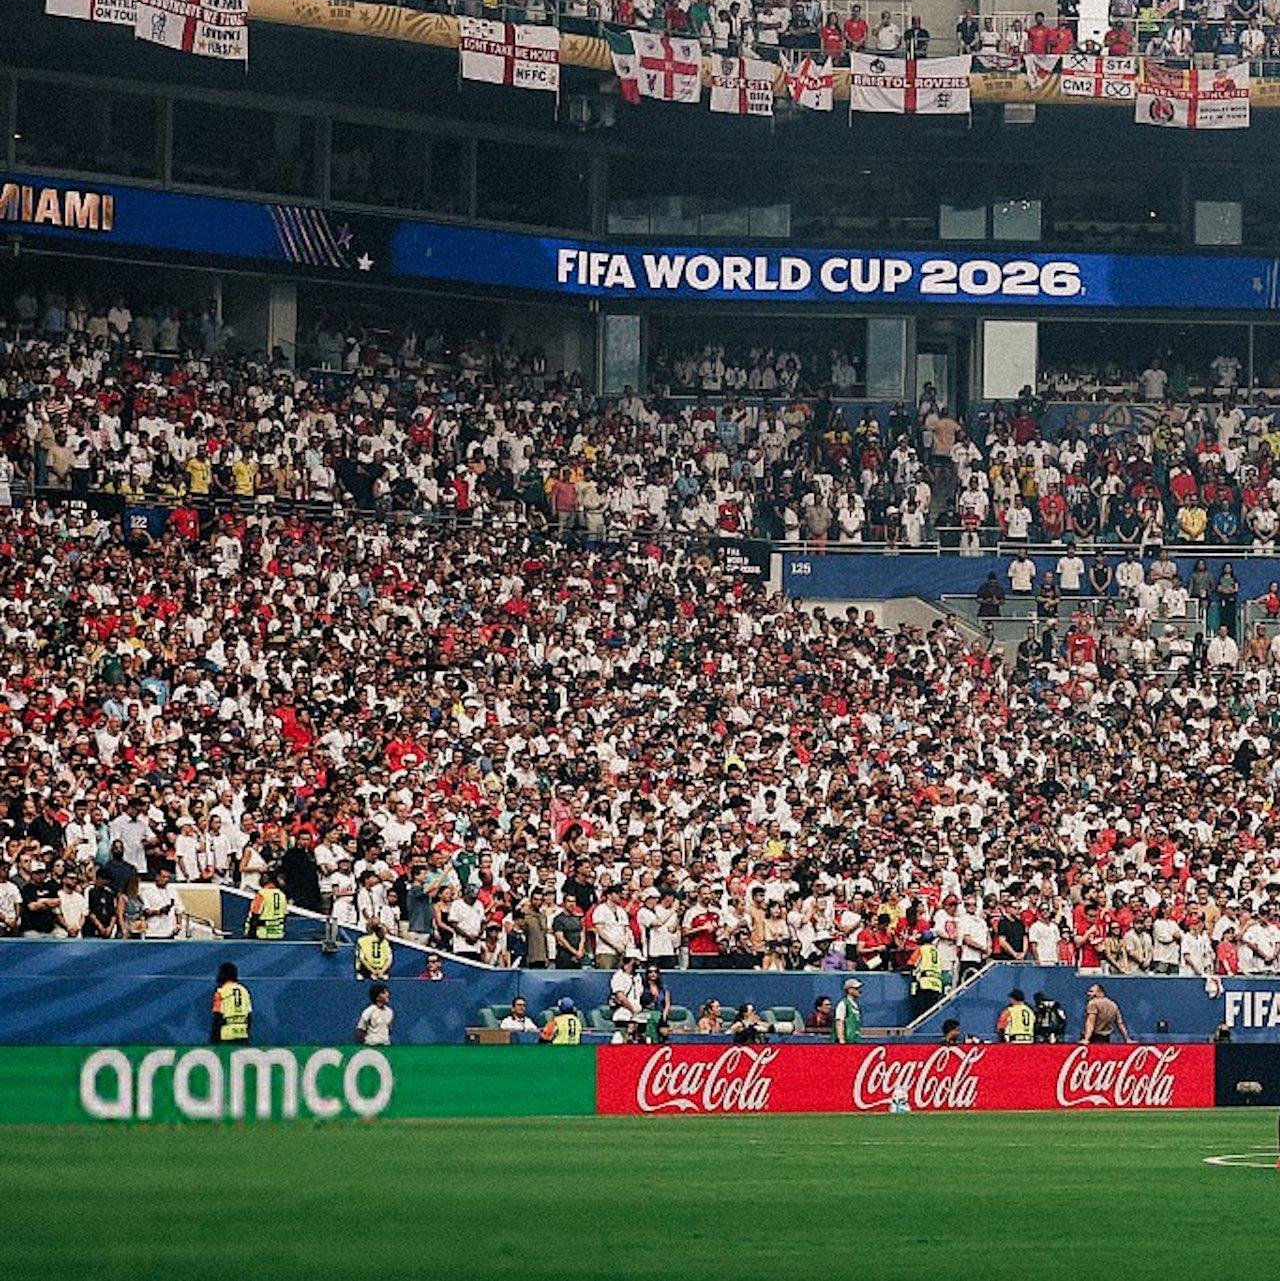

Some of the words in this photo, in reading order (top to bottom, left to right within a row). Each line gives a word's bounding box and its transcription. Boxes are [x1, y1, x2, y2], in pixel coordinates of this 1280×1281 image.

[853, 75, 911, 89] BRISTOL
[915, 77, 968, 89] ROVERS
[1062, 79, 1093, 92] CM2
[1106, 59, 1131, 70] ST4
[558, 248, 639, 289] FIFA
[642, 253, 812, 293] WORLD
[820, 258, 912, 294] CUP
[920, 260, 1082, 296] 2026
[80, 1047, 394, 1119] aramco
[636, 1045, 780, 1113] Coca-Cola
[853, 1045, 986, 1112] Coca-Cola
[1056, 1044, 1183, 1108] Coca-Cola
